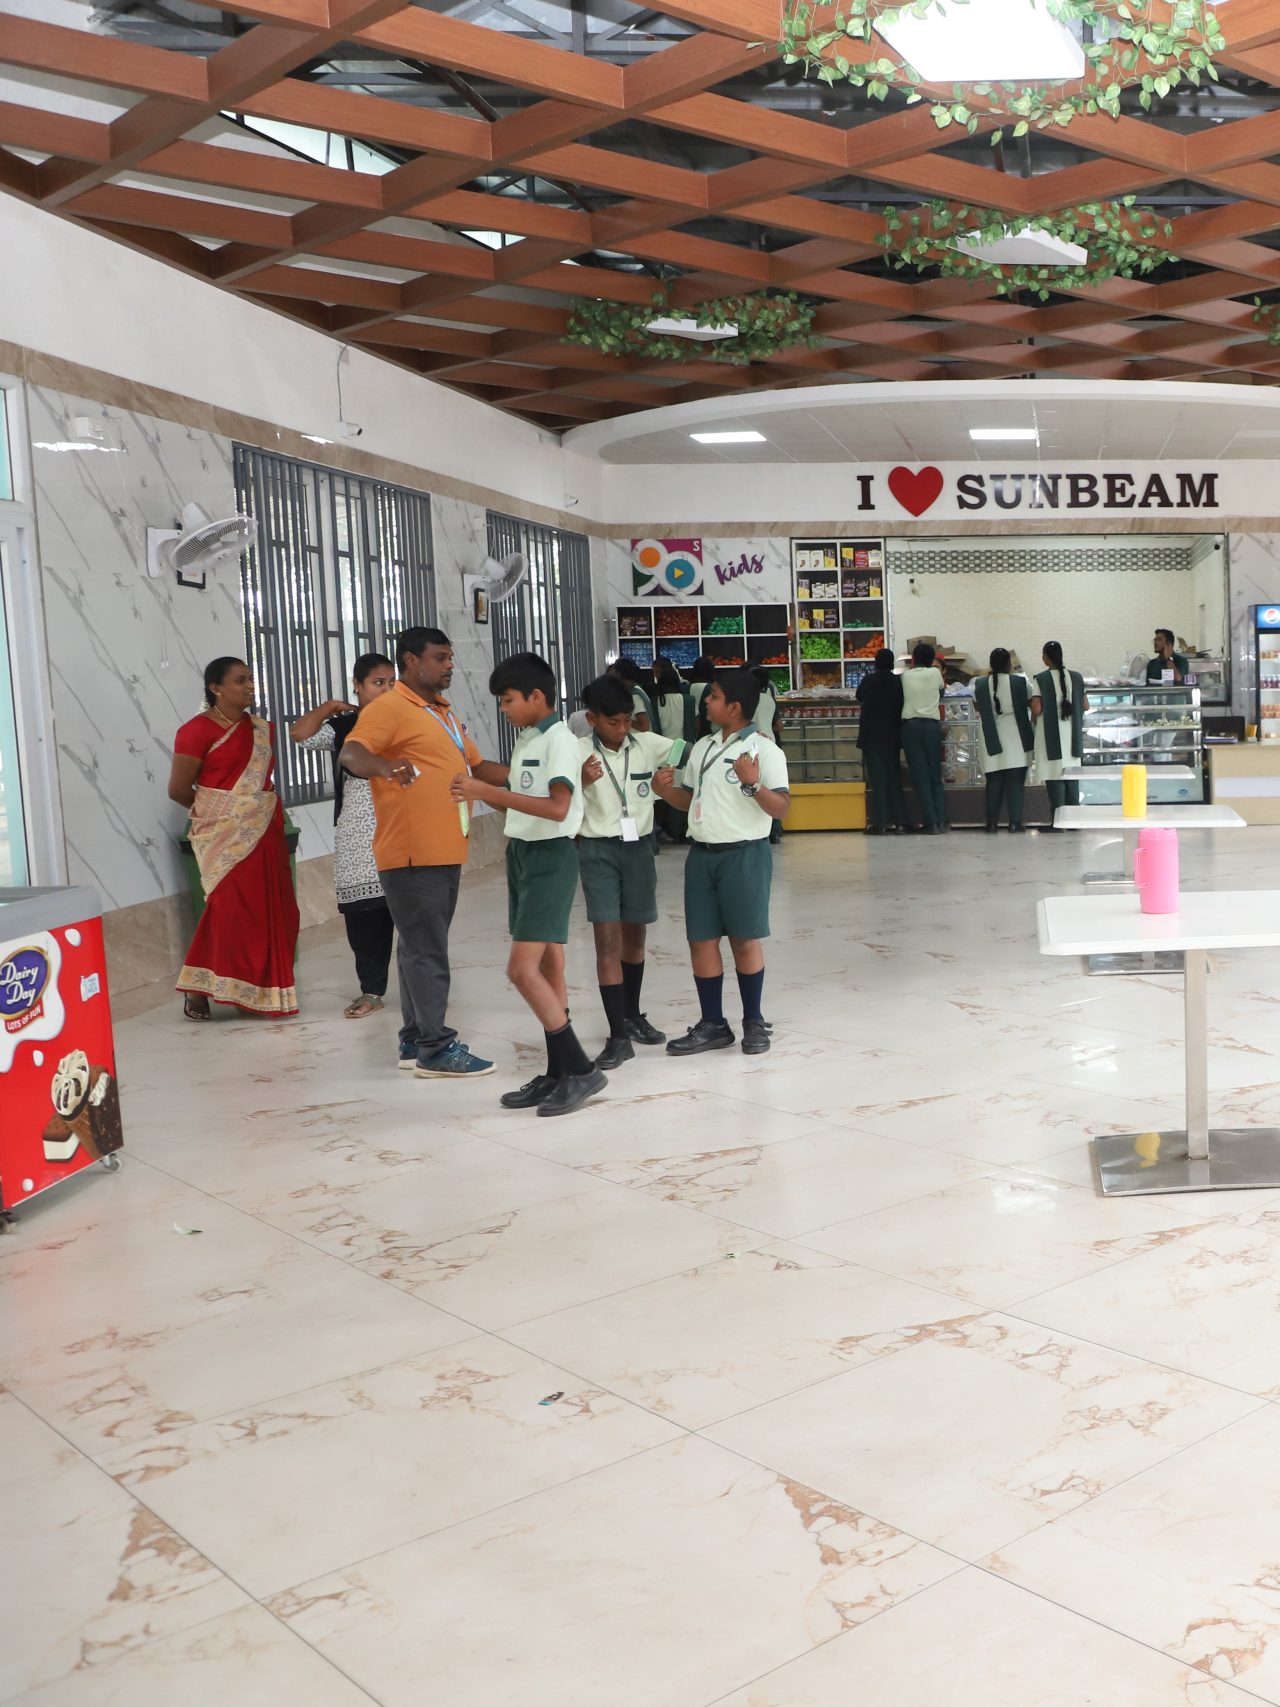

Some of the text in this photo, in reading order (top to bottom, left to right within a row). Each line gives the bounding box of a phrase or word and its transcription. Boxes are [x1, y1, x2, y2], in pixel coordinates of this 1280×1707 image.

[857, 473, 1219, 510] I SUNBEAM
[714, 553, 765, 586] kids
[0, 961, 39, 985] Dairy
[6, 980, 36, 1007] Day
[7, 1004, 41, 1031] LOTS OF FUN
